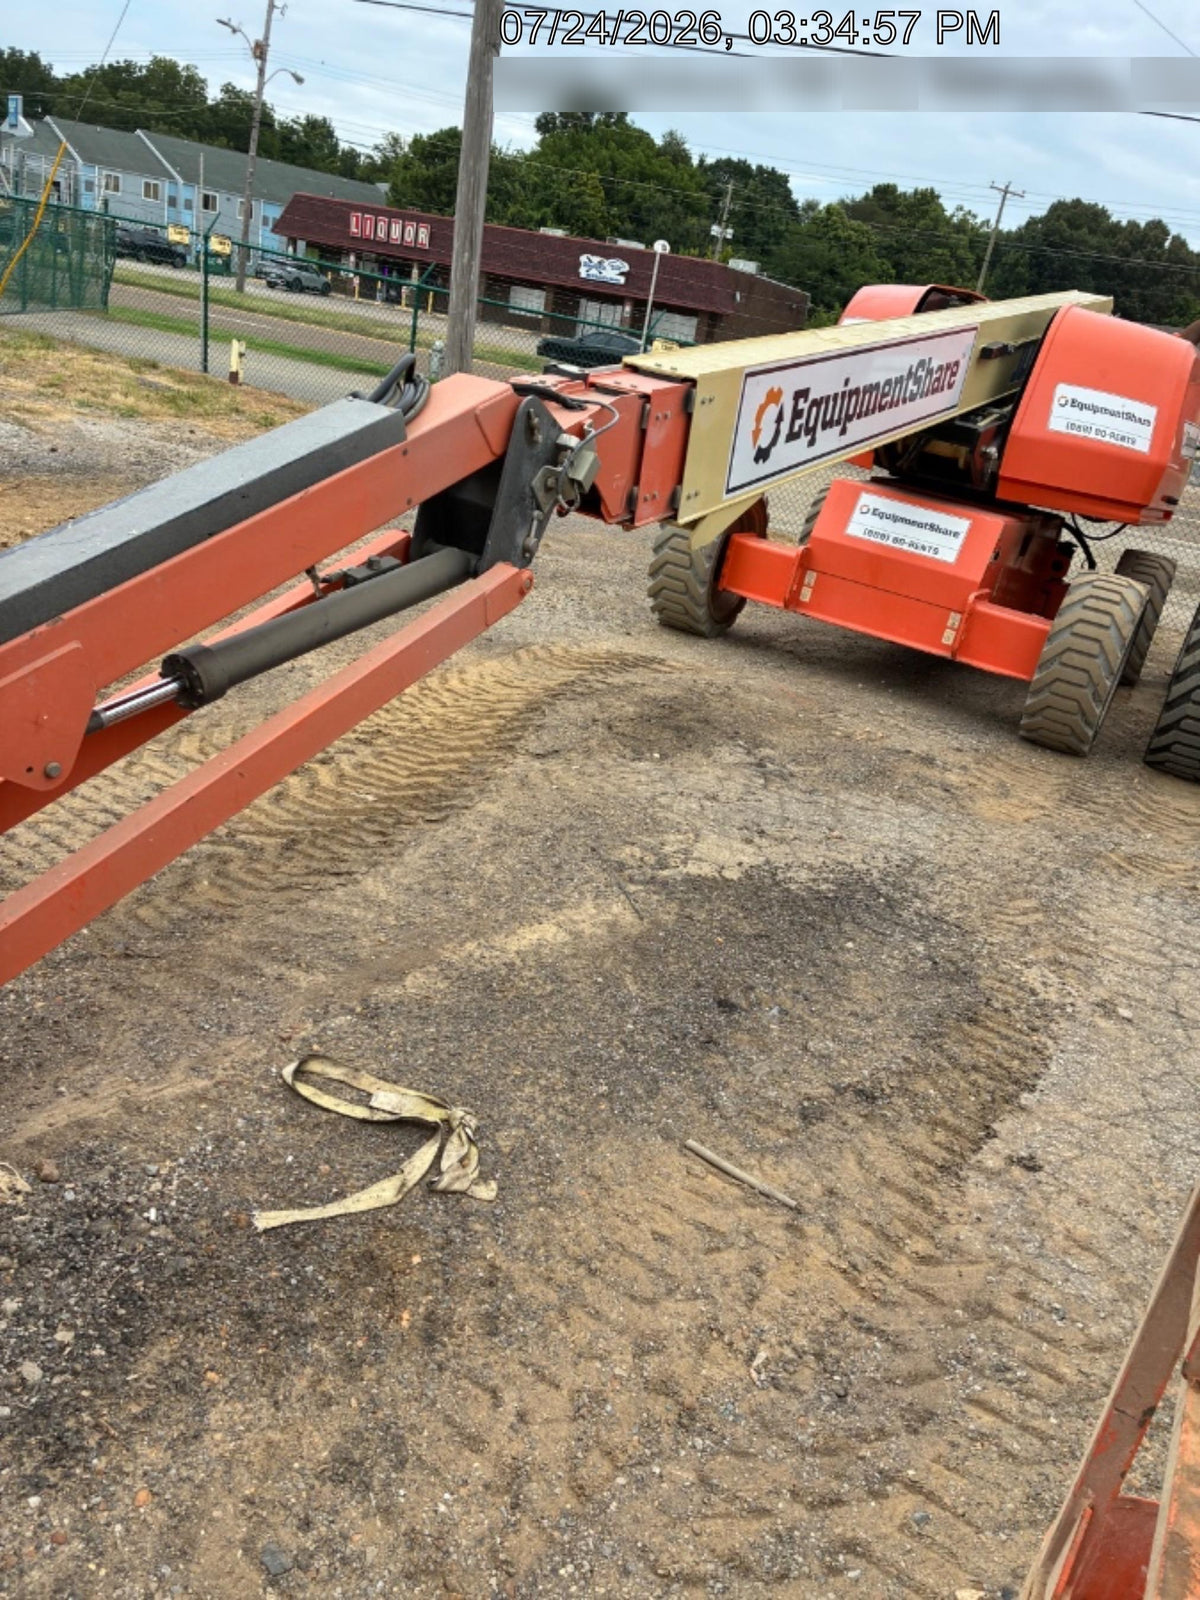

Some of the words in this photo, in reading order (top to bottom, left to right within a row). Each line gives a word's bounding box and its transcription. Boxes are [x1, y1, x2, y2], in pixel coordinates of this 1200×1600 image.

[350, 213, 430, 248] LIQUOR
[785, 357, 961, 448] EquipmentShare
[1070, 397, 1151, 427] EquipmentShare
[871, 508, 960, 539] EquipmentShare
